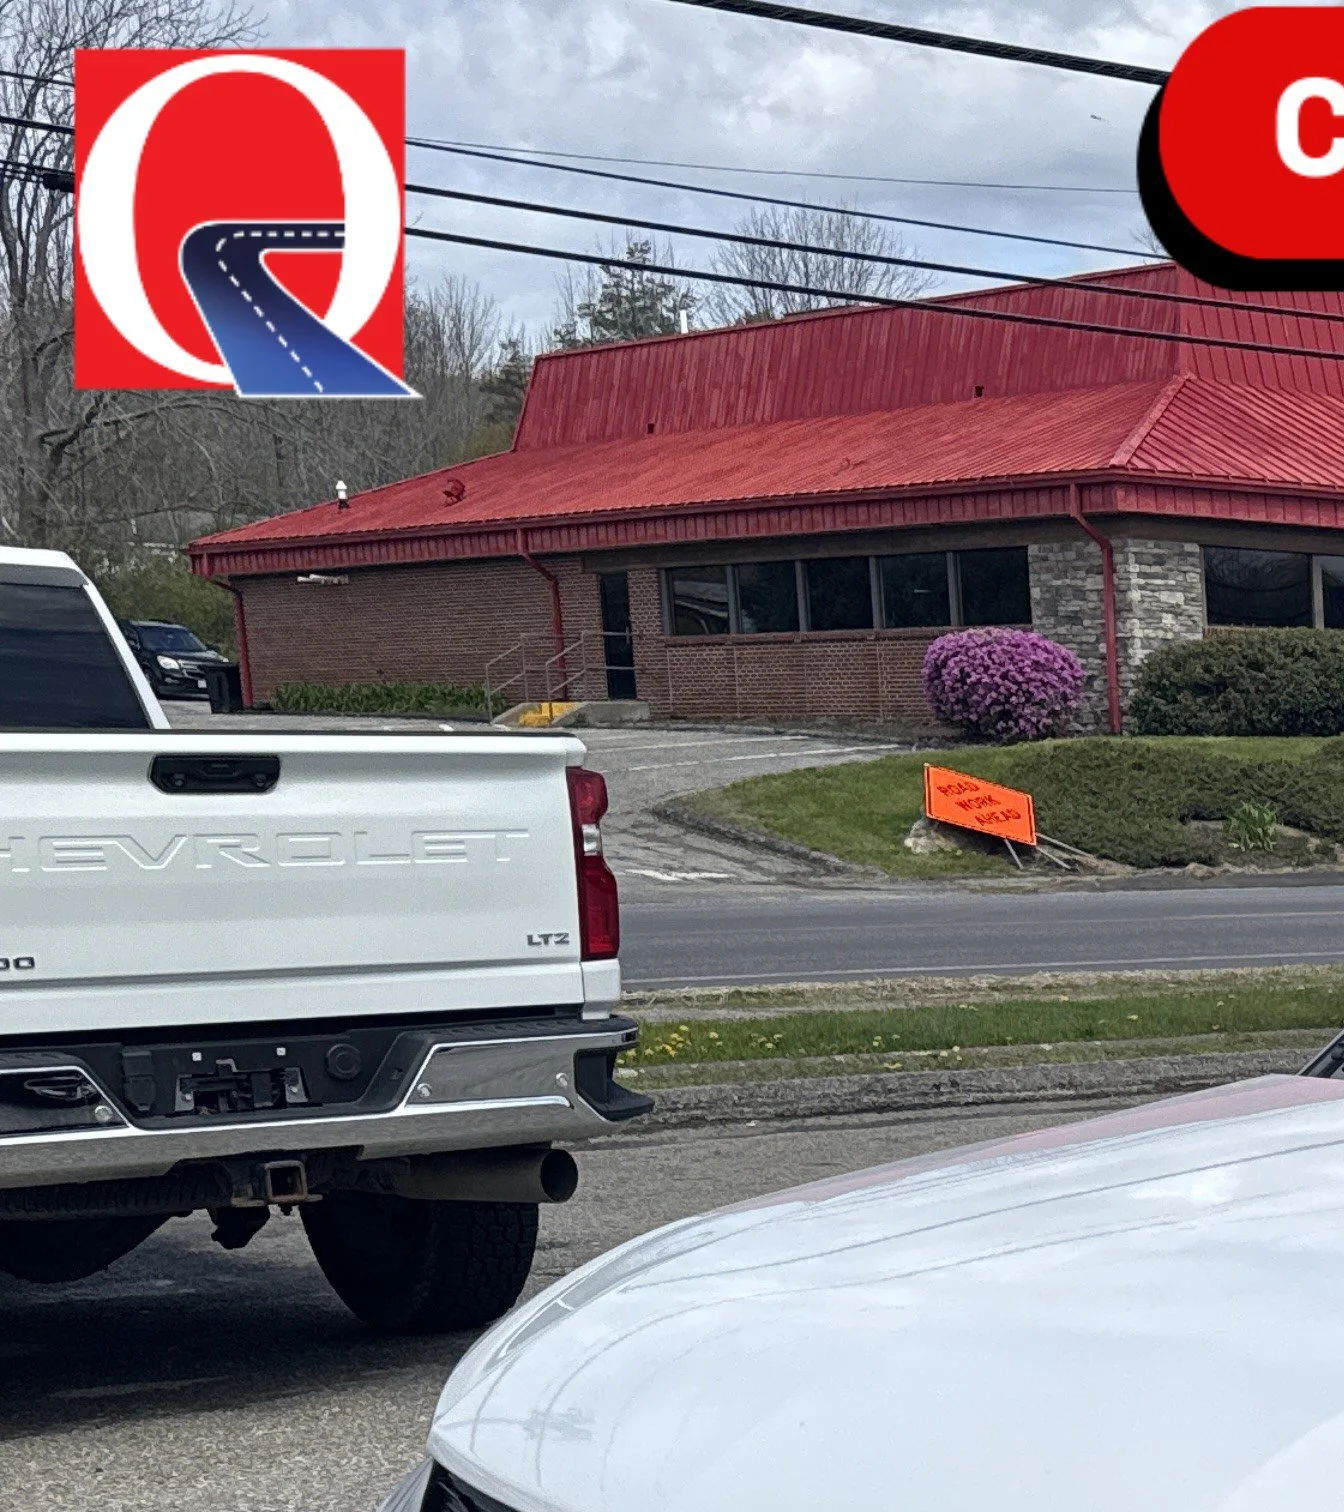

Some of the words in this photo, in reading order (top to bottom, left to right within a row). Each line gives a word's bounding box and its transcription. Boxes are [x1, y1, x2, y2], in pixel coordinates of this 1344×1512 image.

[937, 781, 980, 797] ROAD
[955, 794, 1002, 811] WORK
[974, 808, 1022, 826] AHEAD
[527, 932, 570, 947] LTZ
